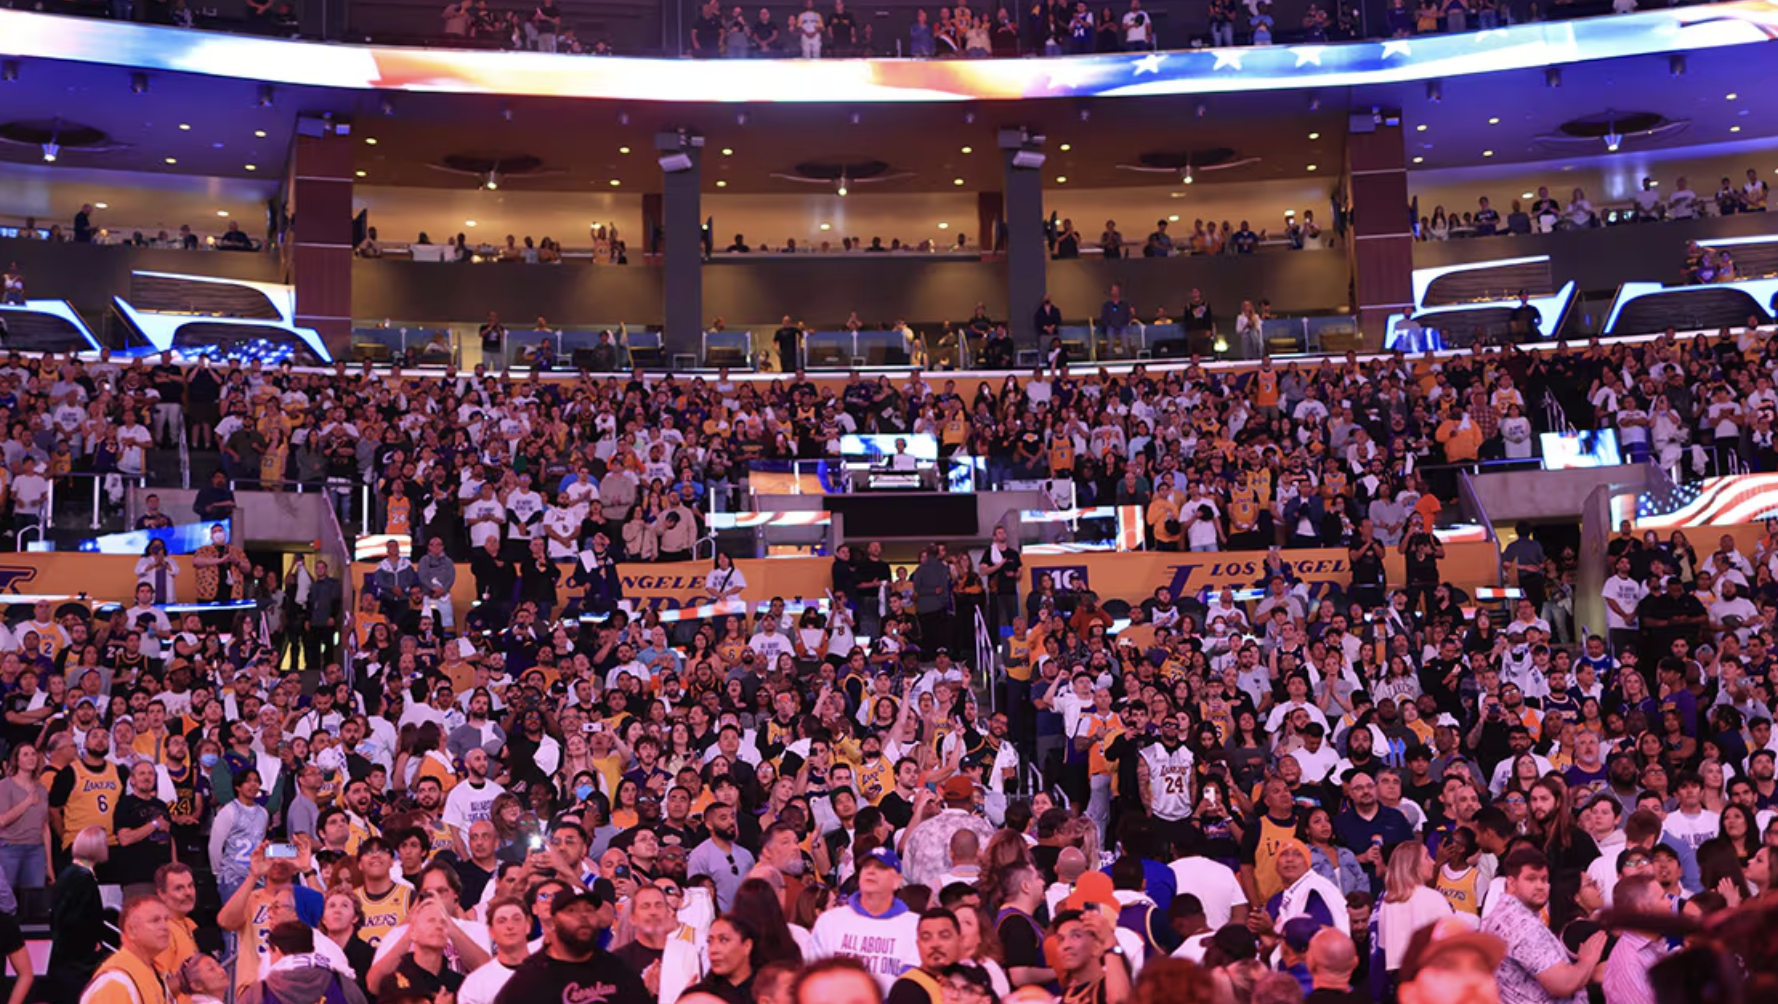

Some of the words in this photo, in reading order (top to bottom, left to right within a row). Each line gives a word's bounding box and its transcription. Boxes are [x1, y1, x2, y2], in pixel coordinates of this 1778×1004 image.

[1210, 561, 1256, 576] LOS
[622, 575, 706, 590] NGELE
[1159, 764, 1188, 776] LAKERS
[83, 779, 117, 792] LAKERS
[1164, 776, 1184, 794] 24
[97, 793, 109, 816] 6
[840, 933, 858, 950] ALL
[860, 935, 896, 955] ABOUT
